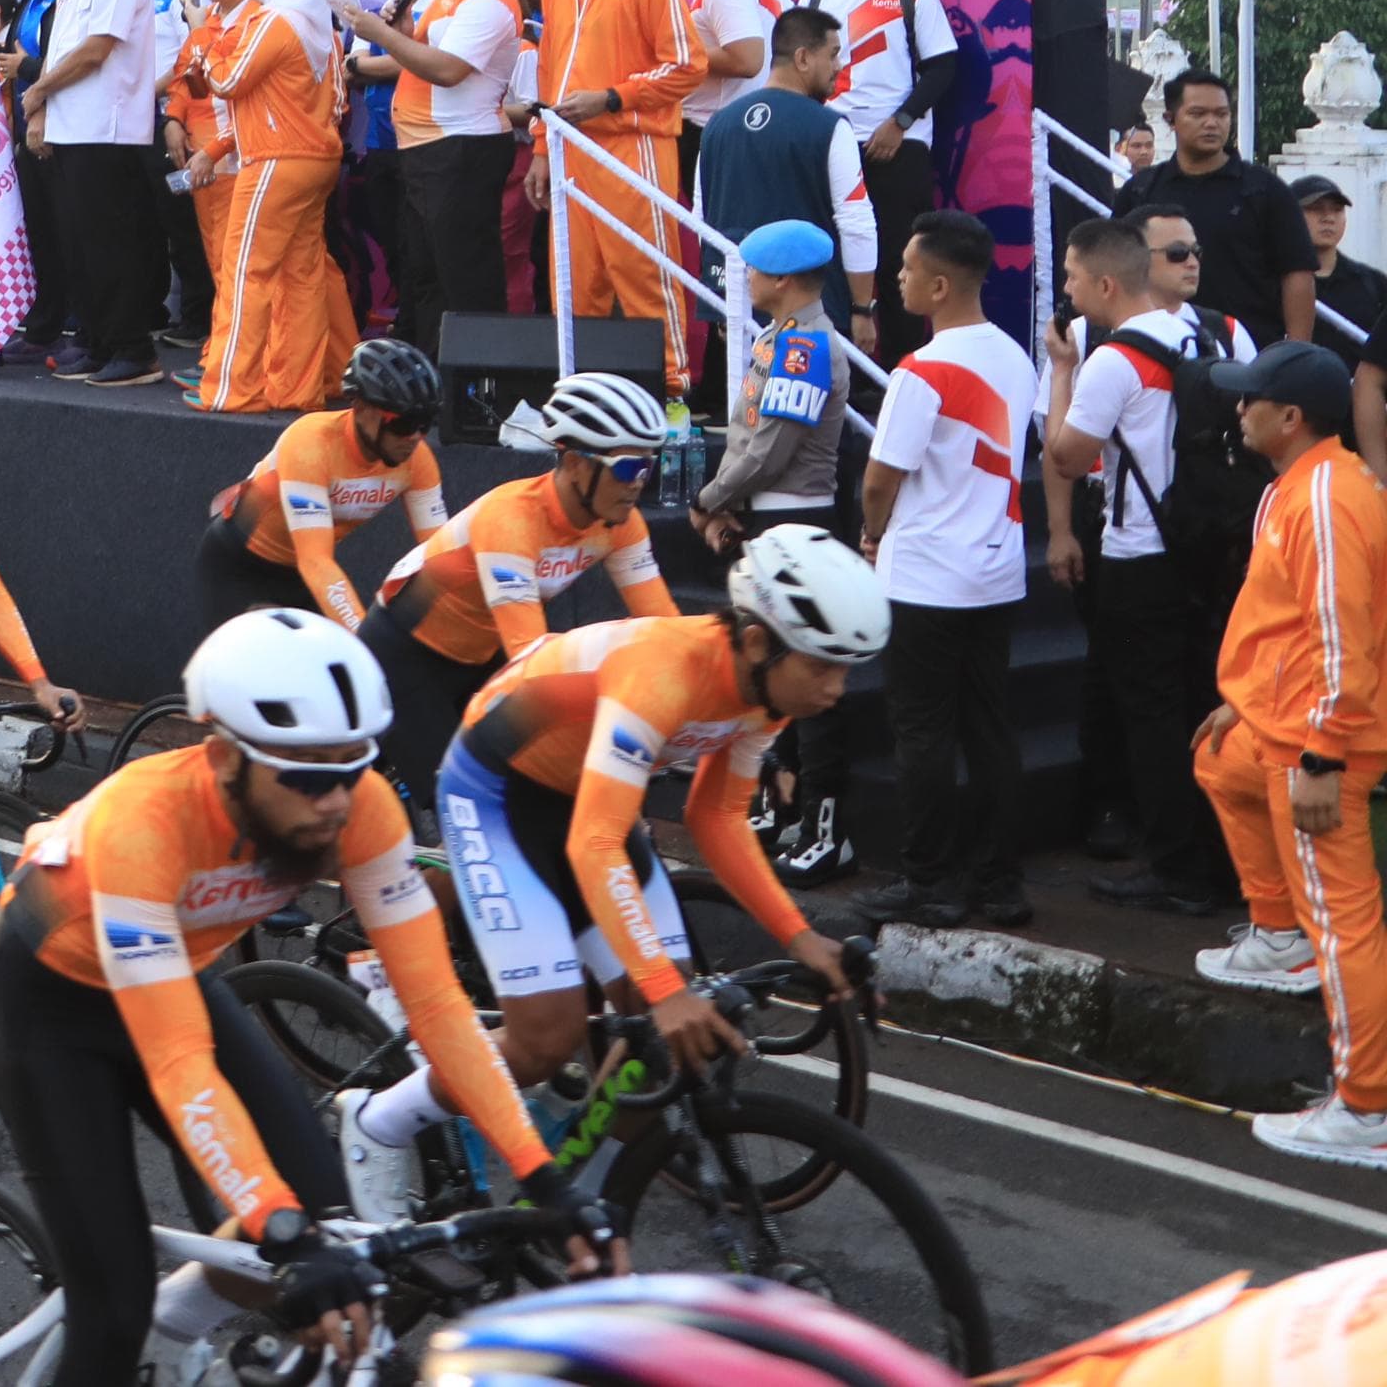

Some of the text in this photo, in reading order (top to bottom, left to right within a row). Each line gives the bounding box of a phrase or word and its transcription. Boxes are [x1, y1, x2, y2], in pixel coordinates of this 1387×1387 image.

[330, 478, 395, 503] Kemala
[327, 580, 361, 630] Kemal
[608, 863, 663, 960] Kemala
[181, 1087, 264, 1217] Kemala
